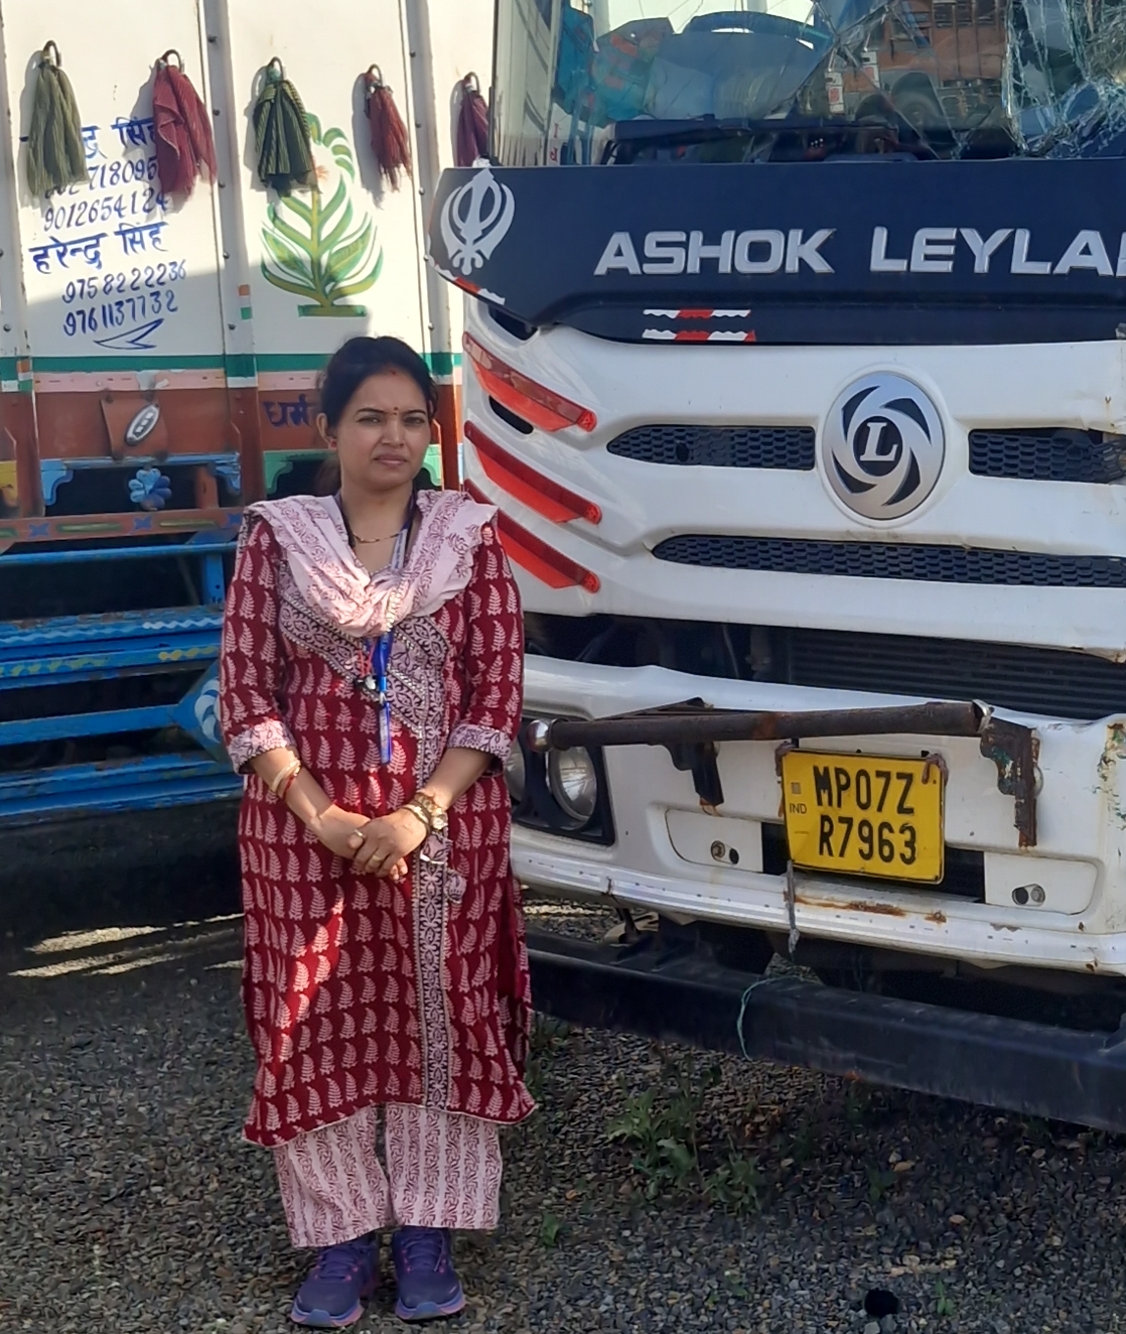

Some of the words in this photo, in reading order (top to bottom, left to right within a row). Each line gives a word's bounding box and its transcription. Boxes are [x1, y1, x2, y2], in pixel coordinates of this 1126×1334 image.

[114, 221, 169, 255] सिंह
[594, 228, 835, 275] ASHOK
[62, 259, 187, 303] 9758222236
[63, 289, 178, 336] 9761137732
[860, 422, 898, 461] L
[789, 803, 808, 814] IND
[813, 765, 915, 815] MP07Z
[819, 814, 917, 865] R7963
